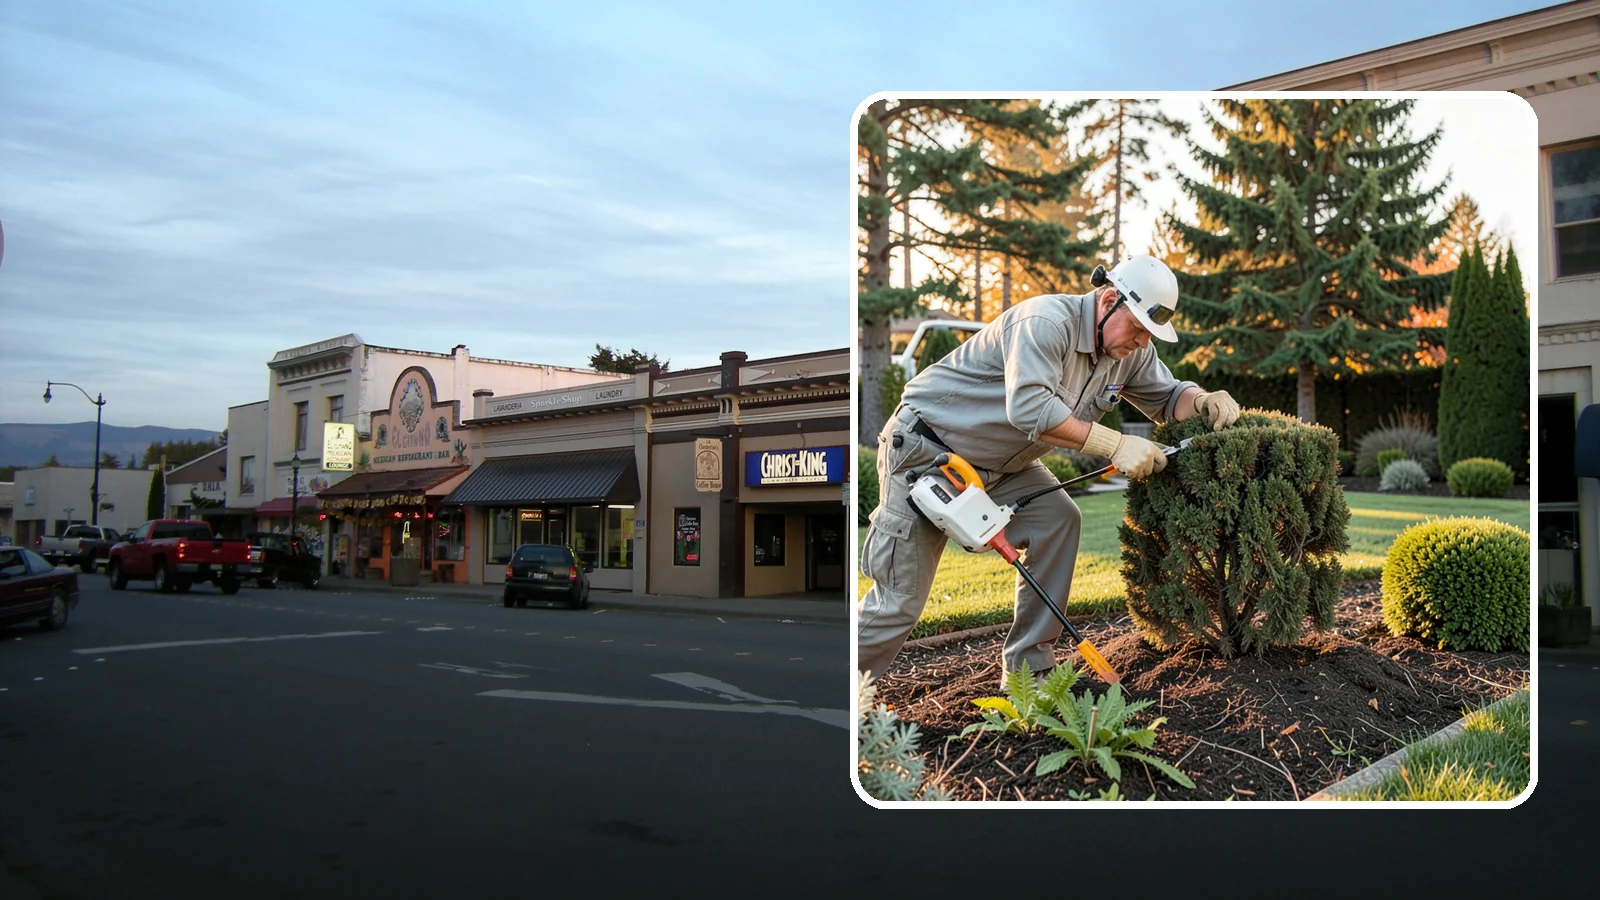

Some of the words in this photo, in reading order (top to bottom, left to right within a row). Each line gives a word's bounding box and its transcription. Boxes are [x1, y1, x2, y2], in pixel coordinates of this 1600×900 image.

[561, 394, 583, 405] Shop
[595, 389, 624, 400] LAUNDRY
[493, 402, 523, 412] LAVANDERIA
[397, 451, 433, 463] RESTAURANT
[437, 450, 450, 459] BAR
[760, 452, 797, 478] CHRIST
[799, 450, 827, 476] KING
